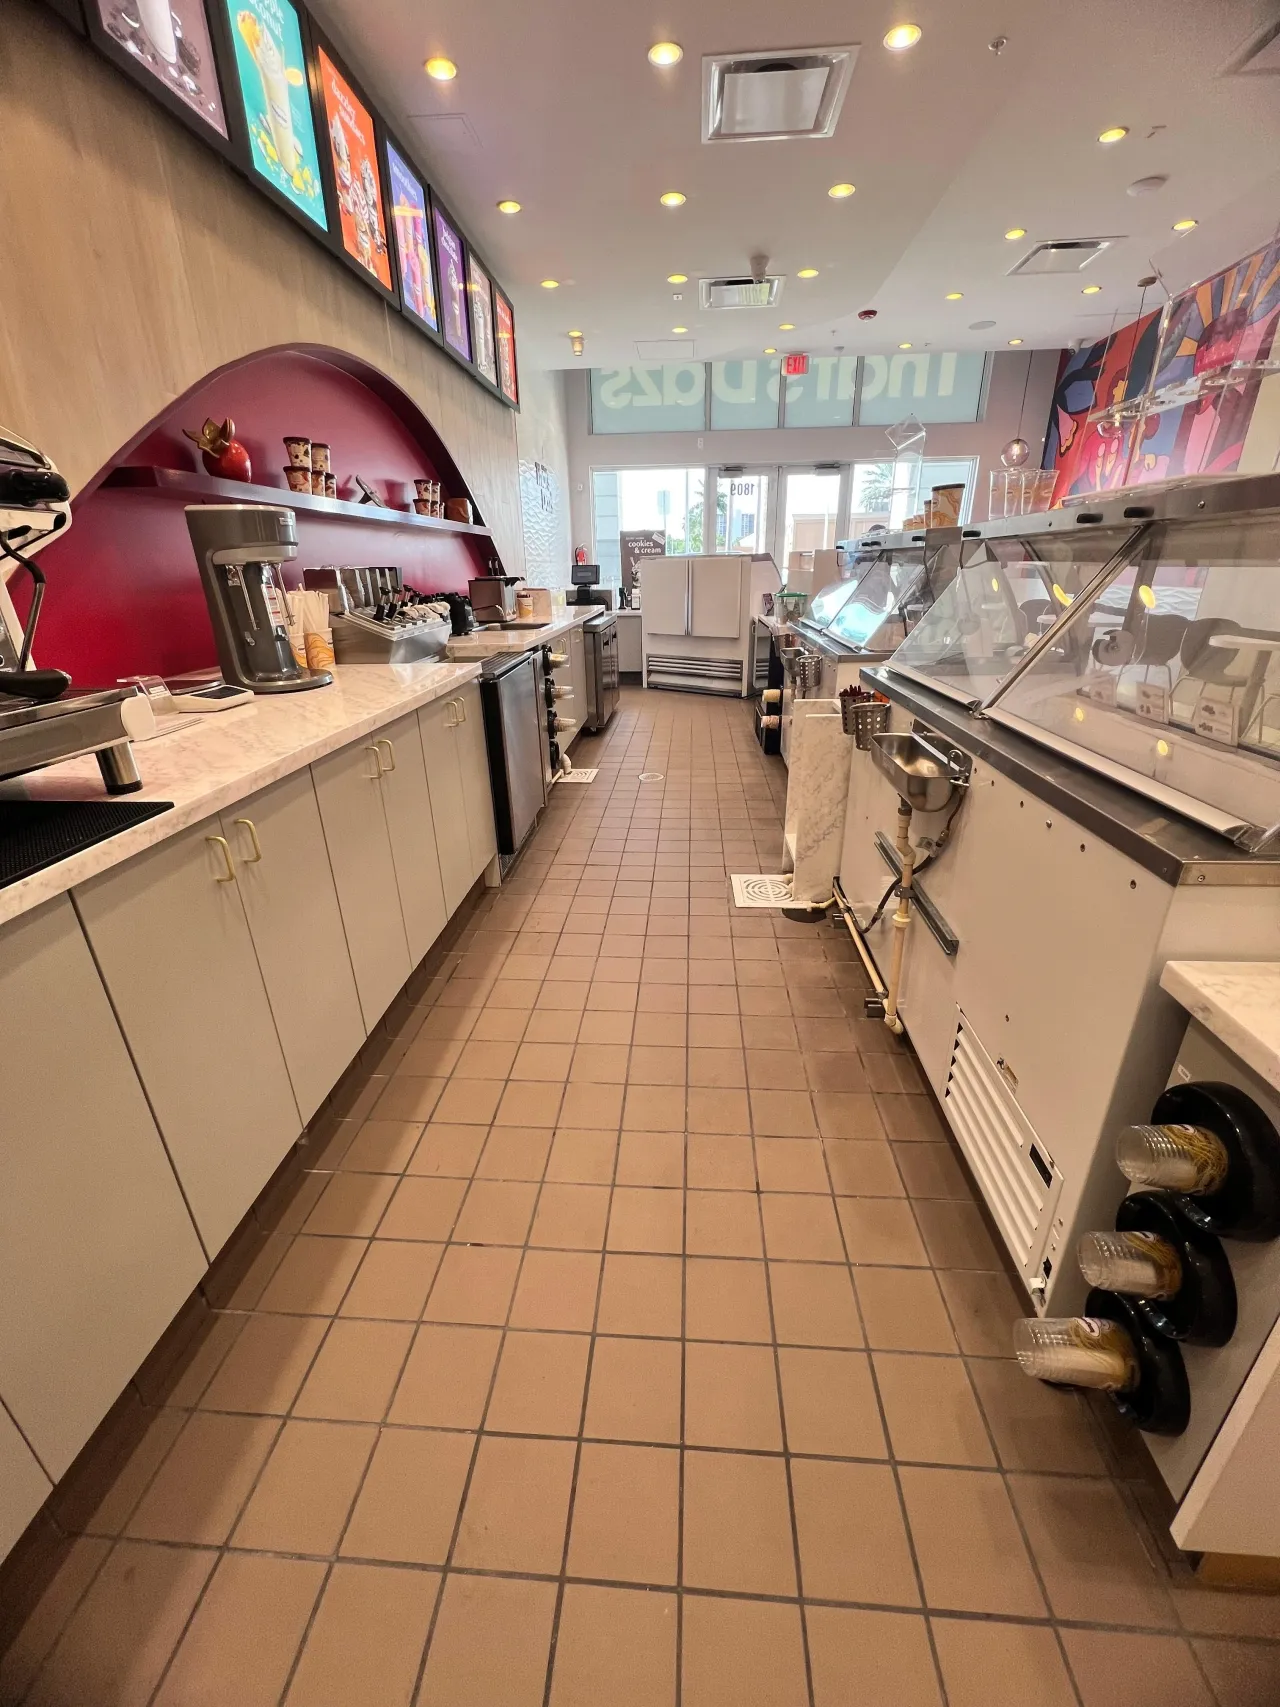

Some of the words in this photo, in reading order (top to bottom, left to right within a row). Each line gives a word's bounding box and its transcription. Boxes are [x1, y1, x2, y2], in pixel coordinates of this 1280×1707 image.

[787, 356, 805, 374] EXIT
[628, 539, 654, 548] cookies
[634, 546, 640, 554] &
